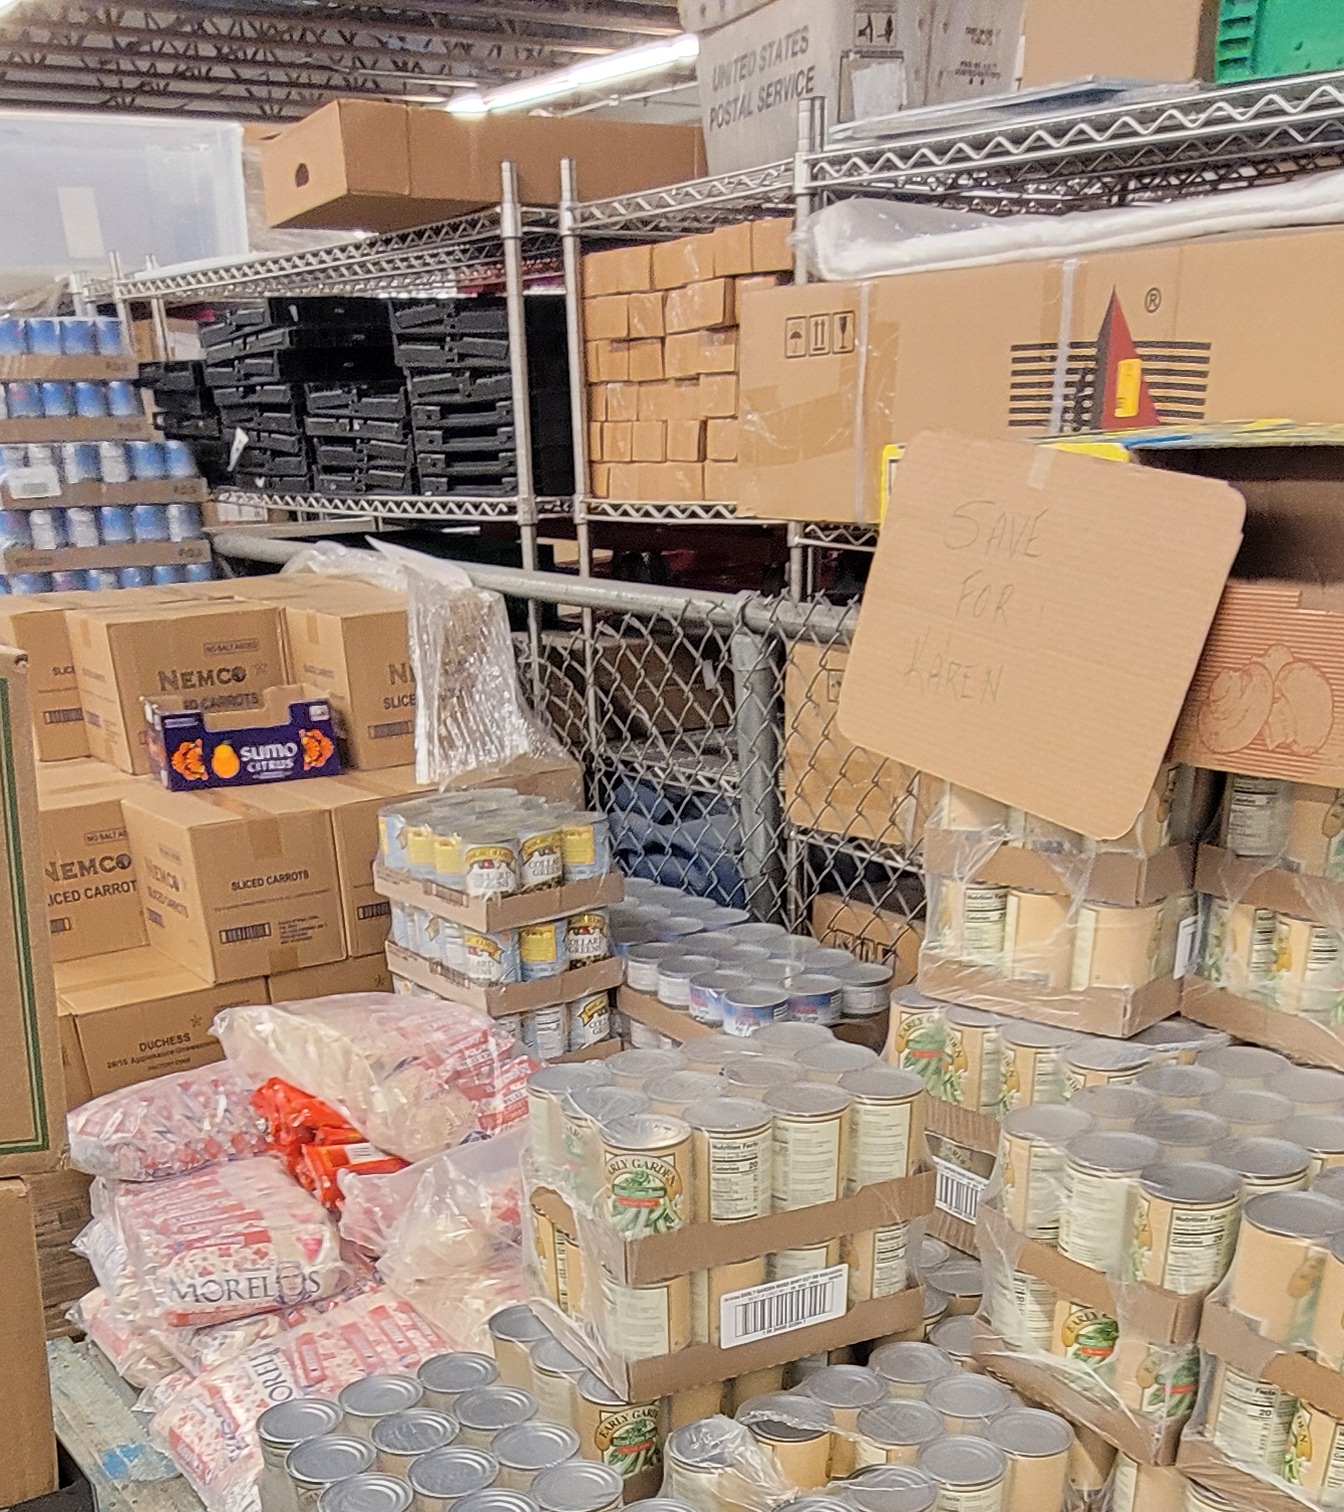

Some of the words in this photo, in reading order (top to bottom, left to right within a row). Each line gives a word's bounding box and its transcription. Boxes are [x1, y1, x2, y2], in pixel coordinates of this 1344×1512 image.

[712, 56, 756, 92] UNITED
[758, 25, 809, 72] STATES
[709, 99, 754, 132] POSTAL
[756, 66, 816, 112] SERVICE
[943, 500, 1049, 558] SAVE
[956, 569, 1014, 625] FOR
[904, 624, 1003, 703] KAREN
[158, 666, 247, 691] NEMCO
[246, 758, 294, 773] CITRUS
[231, 876, 264, 892] SLICED
[139, 1033, 191, 1051] DUCHESS
[631, 1159, 677, 1187] GARDEN
[1212, 1234, 1223, 1243] 20
[1258, 1407, 1272, 1417] 20
[599, 1413, 629, 1439] EARLY
